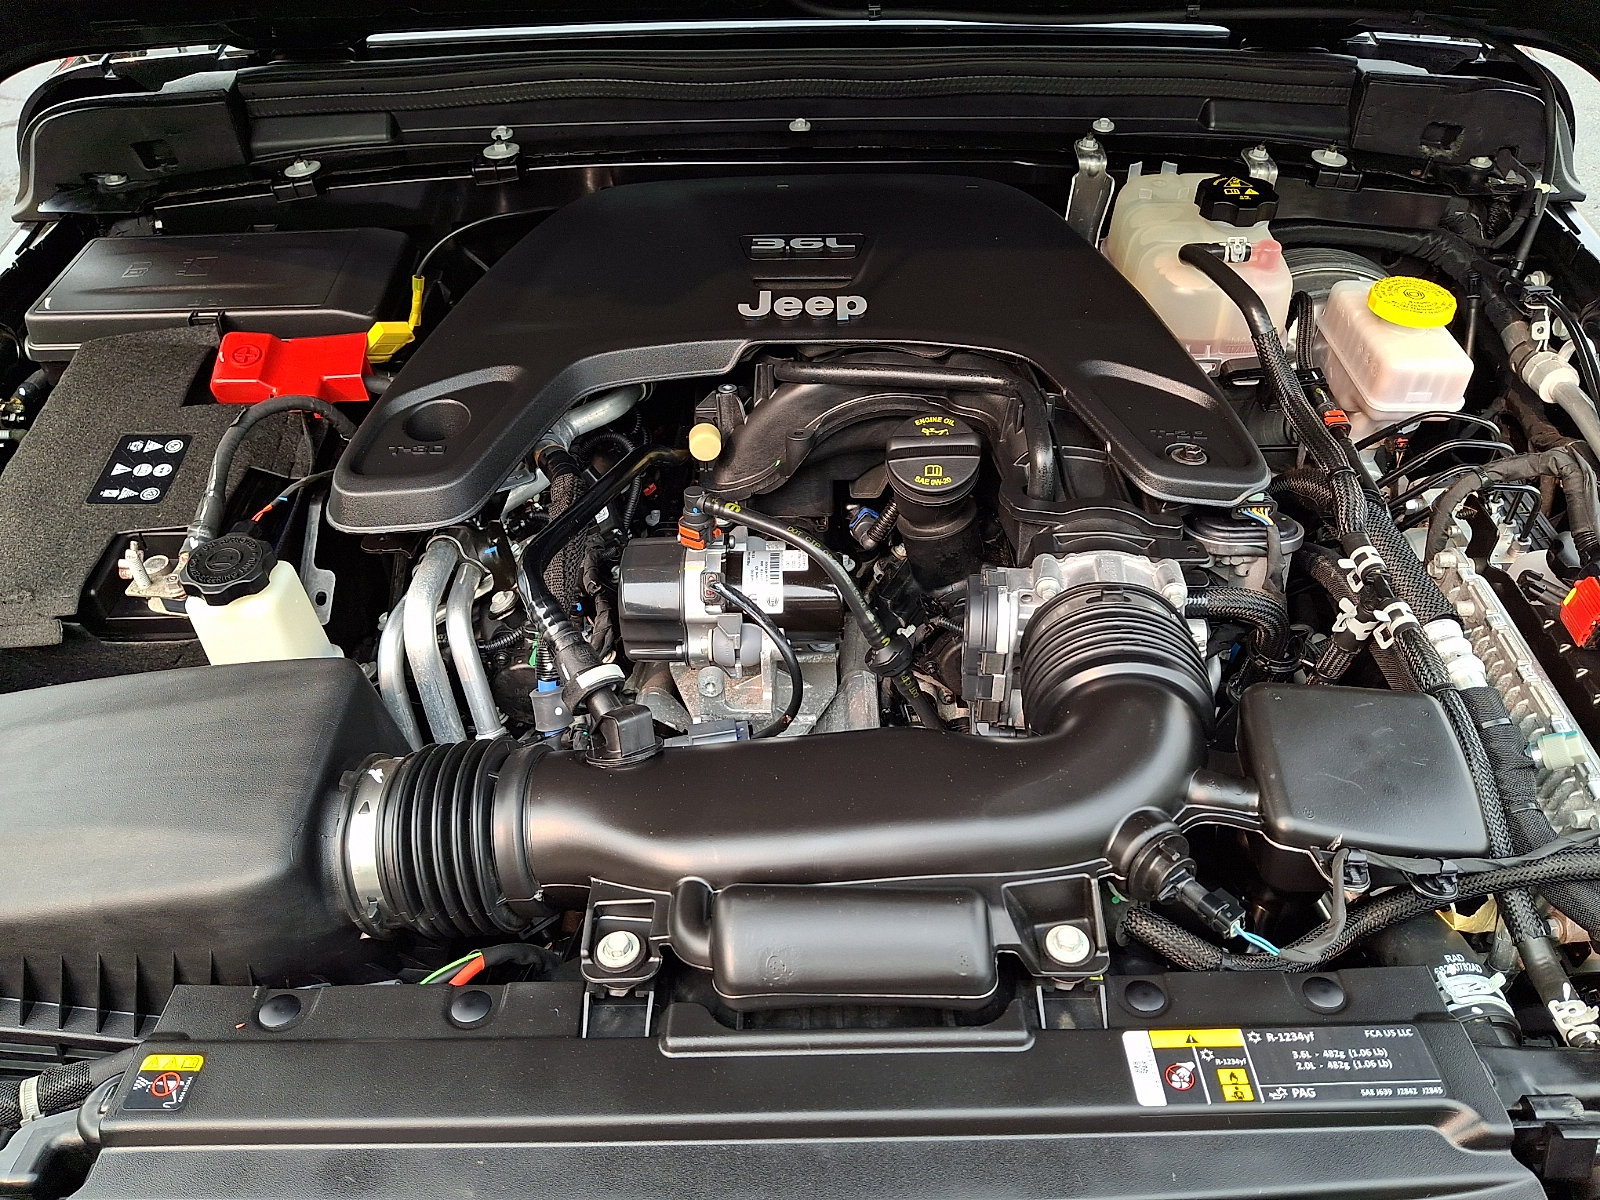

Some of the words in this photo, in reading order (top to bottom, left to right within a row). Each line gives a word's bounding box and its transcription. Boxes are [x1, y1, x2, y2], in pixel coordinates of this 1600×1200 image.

[751, 237, 856, 250] 3.6L
[738, 290, 868, 322] Jeep
[914, 416, 943, 426] ENGINE
[943, 417, 955, 427] OIL
[914, 475, 930, 485] SAE
[1443, 953, 1466, 964] RAD
[1266, 1031, 1315, 1044] R-1234yf
[1364, 1029, 1383, 1039] FCA
[1383, 1029, 1397, 1038] US
[1397, 1028, 1415, 1038] LLC
[1291, 1050, 1313, 1060] 3.6L
[1322, 1049, 1346, 1060] 482g
[1348, 1048, 1373, 1059] (1.06
[1373, 1047, 1388, 1058] Lb)
[1215, 1057, 1248, 1067] R-1234yf
[1295, 1061, 1317, 1071] 2.0L
[1327, 1060, 1351, 1071] 482g
[1352, 1059, 1377, 1070] (1.06
[1377, 1058, 1393, 1070] Lb)
[1291, 1087, 1317, 1099] PAG
[1360, 1088, 1375, 1097] SAE
